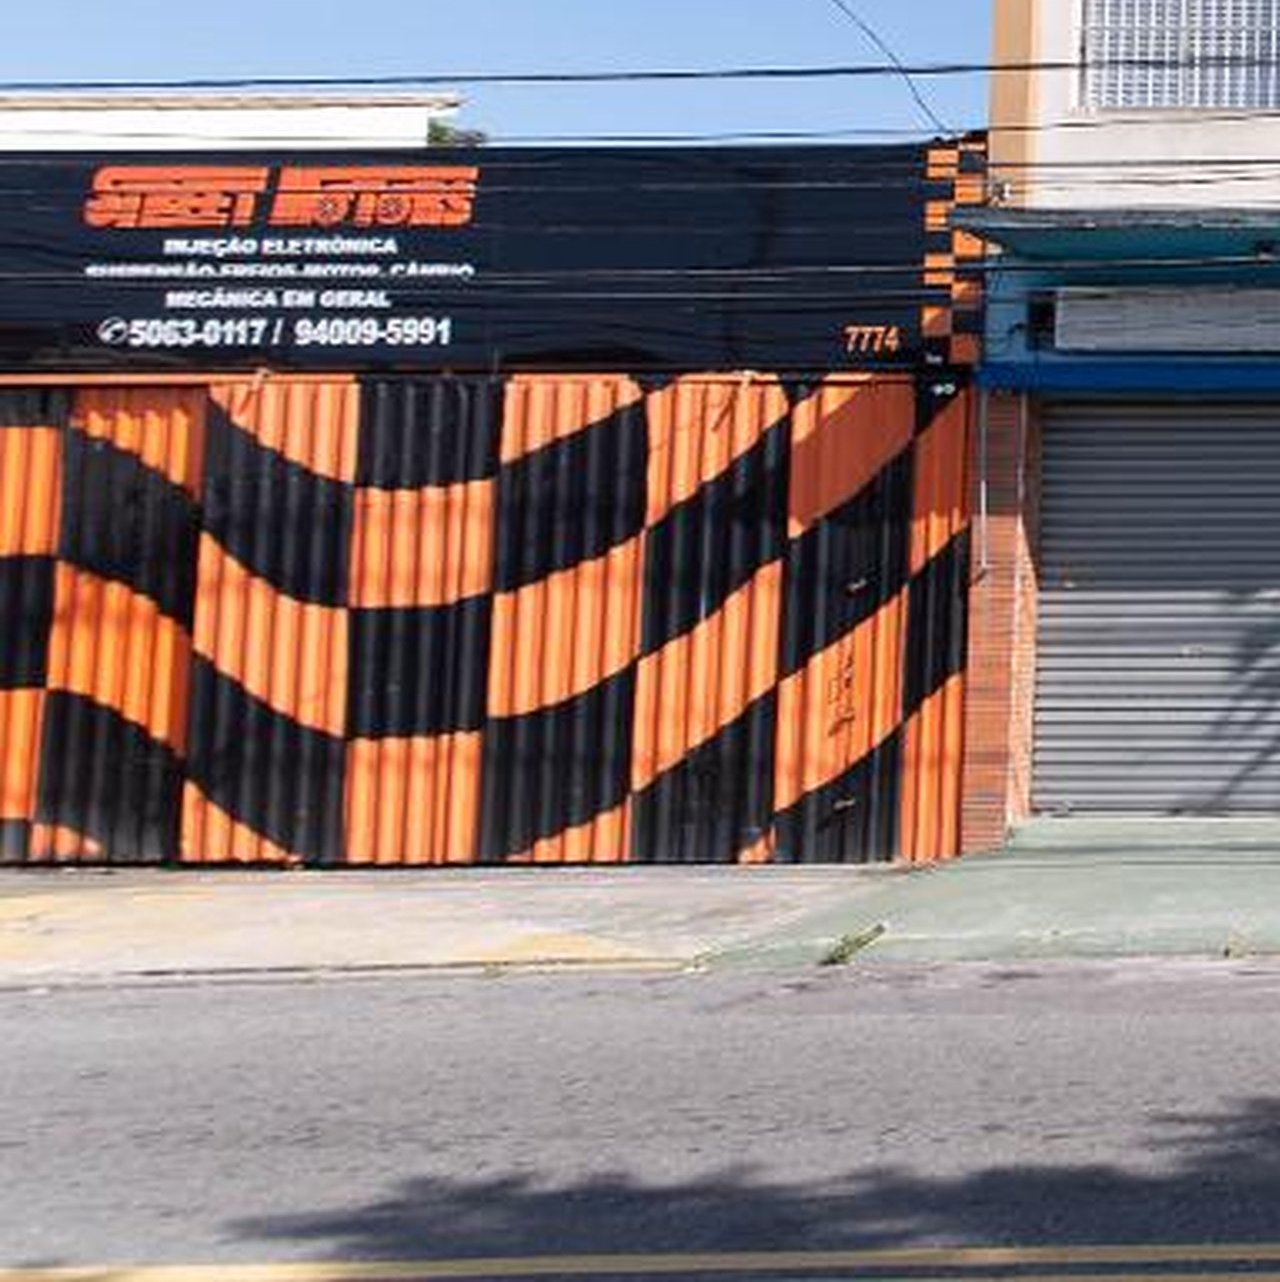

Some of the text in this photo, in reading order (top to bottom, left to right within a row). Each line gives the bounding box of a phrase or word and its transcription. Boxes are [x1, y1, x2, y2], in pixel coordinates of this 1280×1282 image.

[163, 236, 399, 256] INJEÇÃO ELETRÔNICA
[165, 287, 391, 308] MECÂNICA EM GERAL
[128, 319, 267, 346] 5063-0117
[294, 318, 451, 346] 94009-5991
[845, 326, 900, 352] 7774
